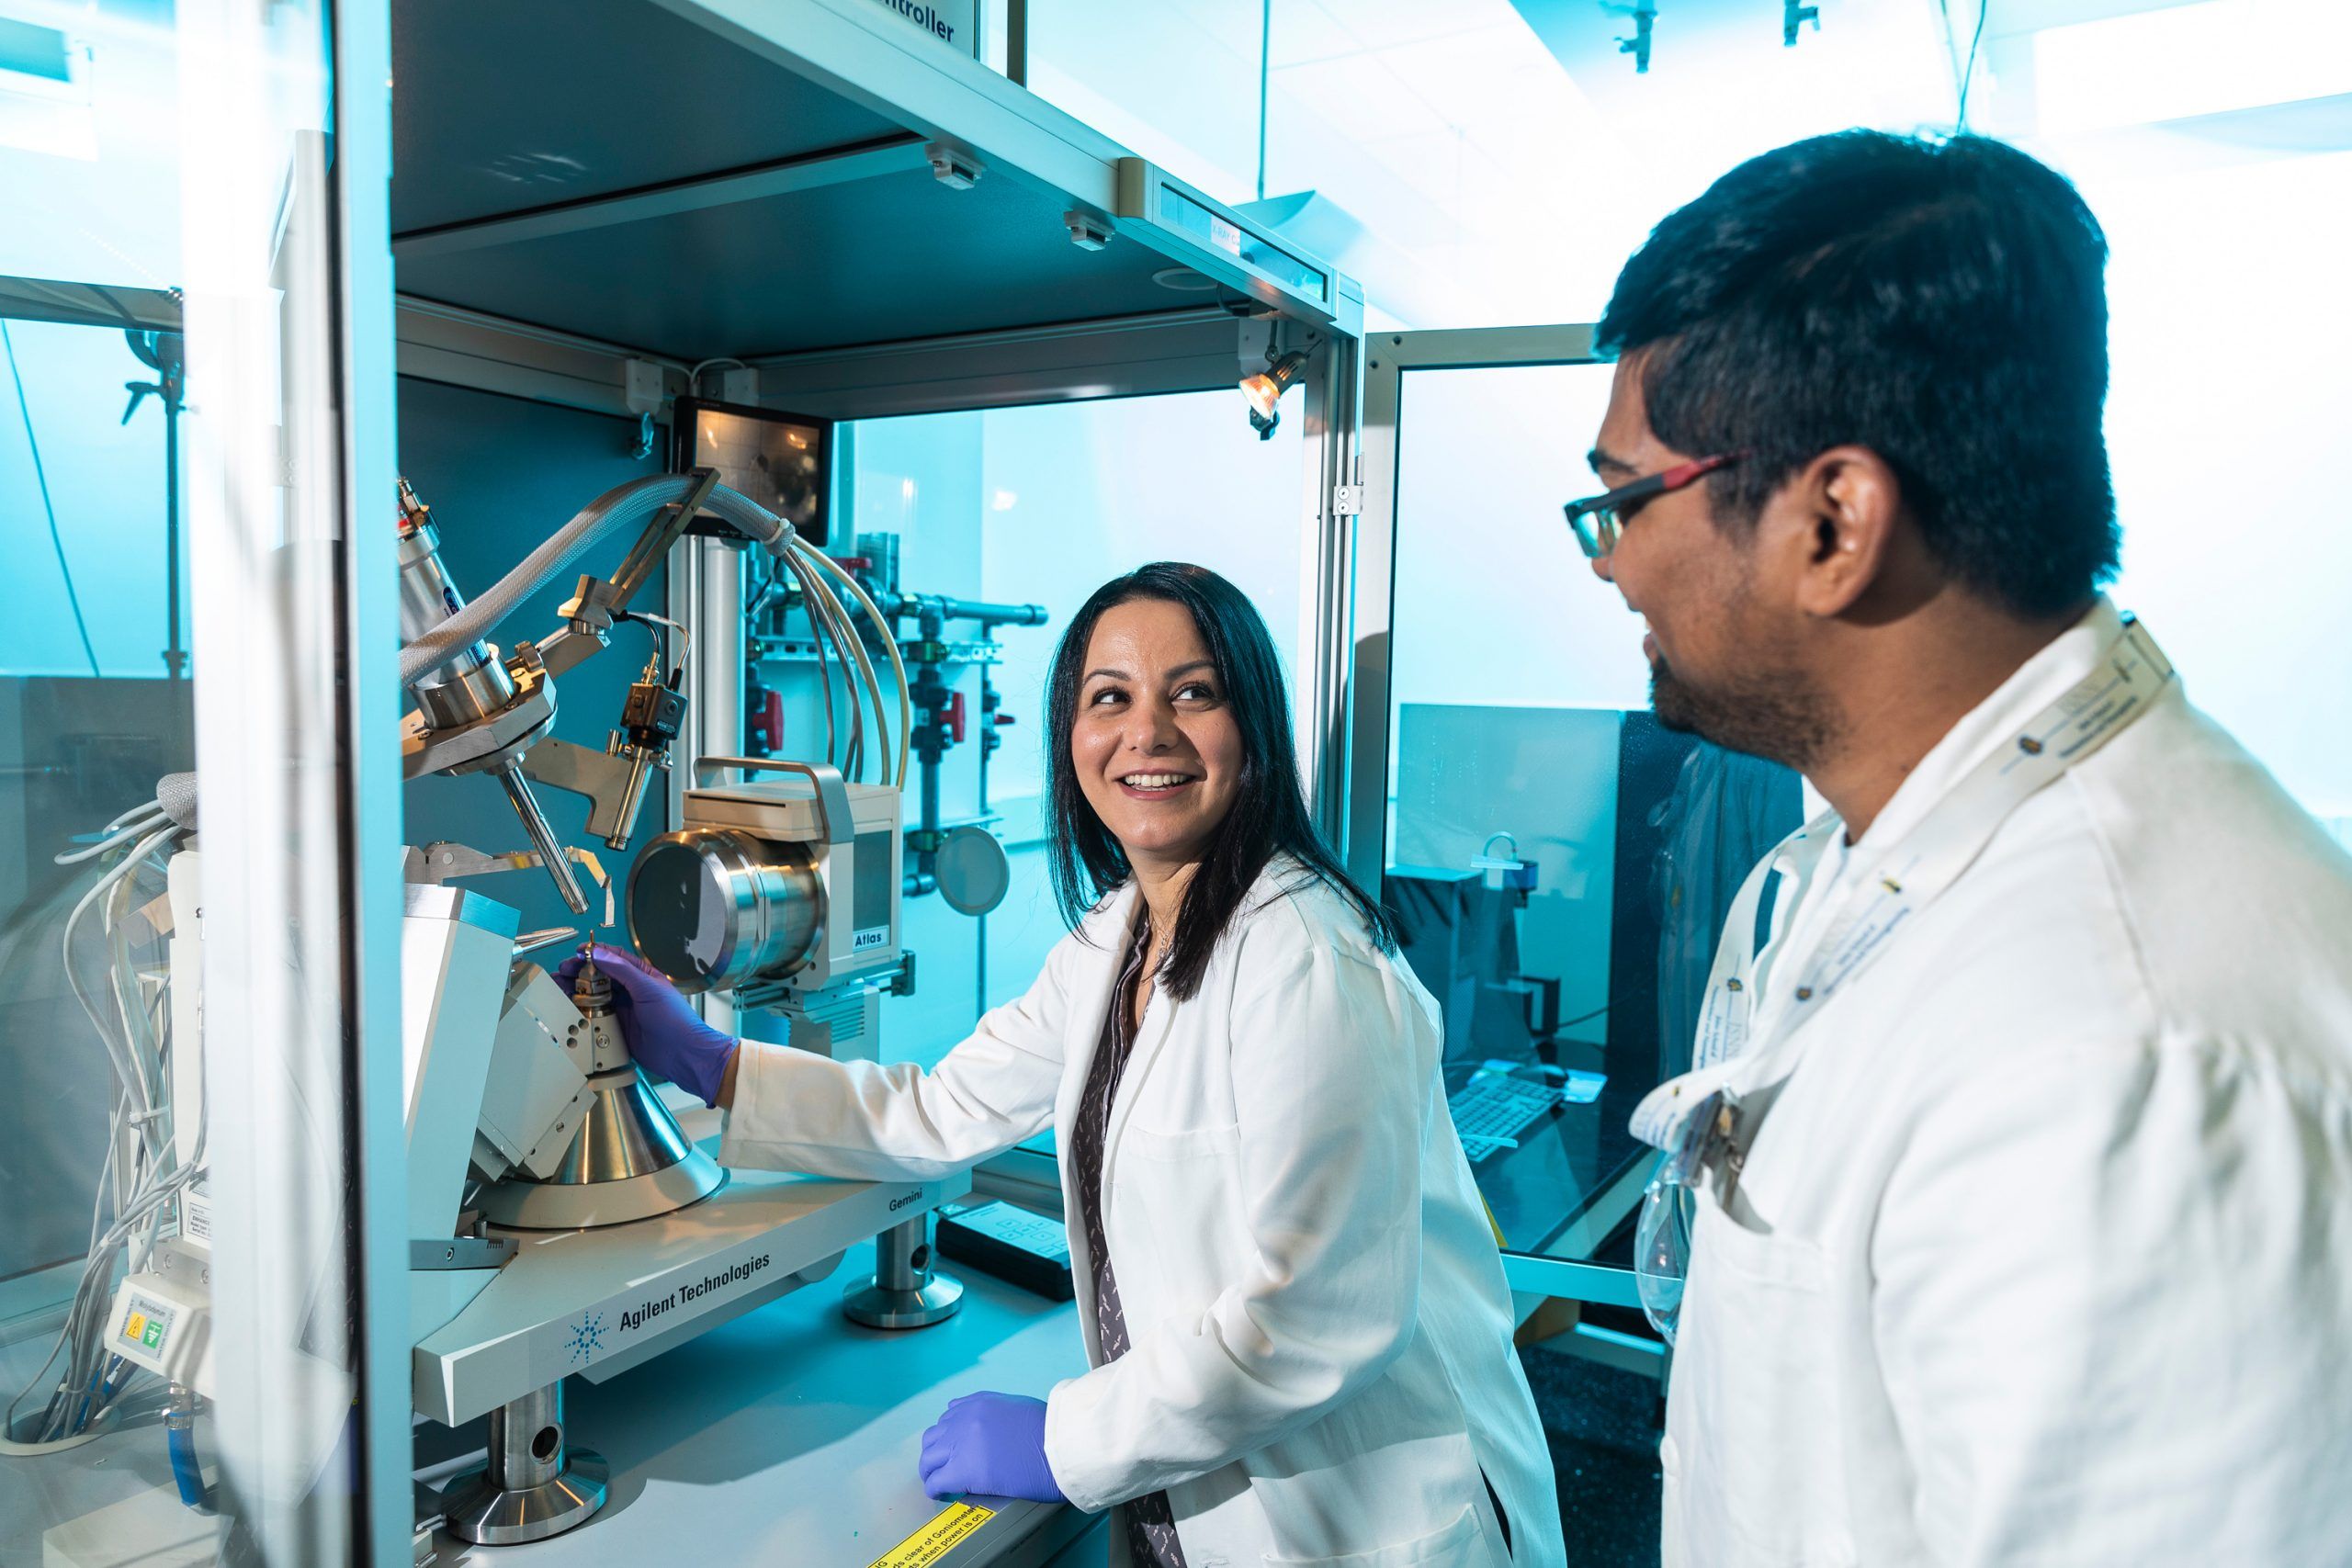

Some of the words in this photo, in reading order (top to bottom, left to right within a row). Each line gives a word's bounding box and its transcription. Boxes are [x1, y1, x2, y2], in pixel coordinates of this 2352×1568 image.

[854, 933, 882, 947] Atlas
[888, 1187, 922, 1212] Gemini
[620, 1292, 675, 1332] Agilent
[678, 1253, 770, 1304] Technologies
[904, 1545, 924, 1561] clear
[924, 1537, 934, 1546] of
[920, 1546, 942, 1562] when
[940, 1527, 965, 1547] power
[971, 1514, 984, 1522] on
